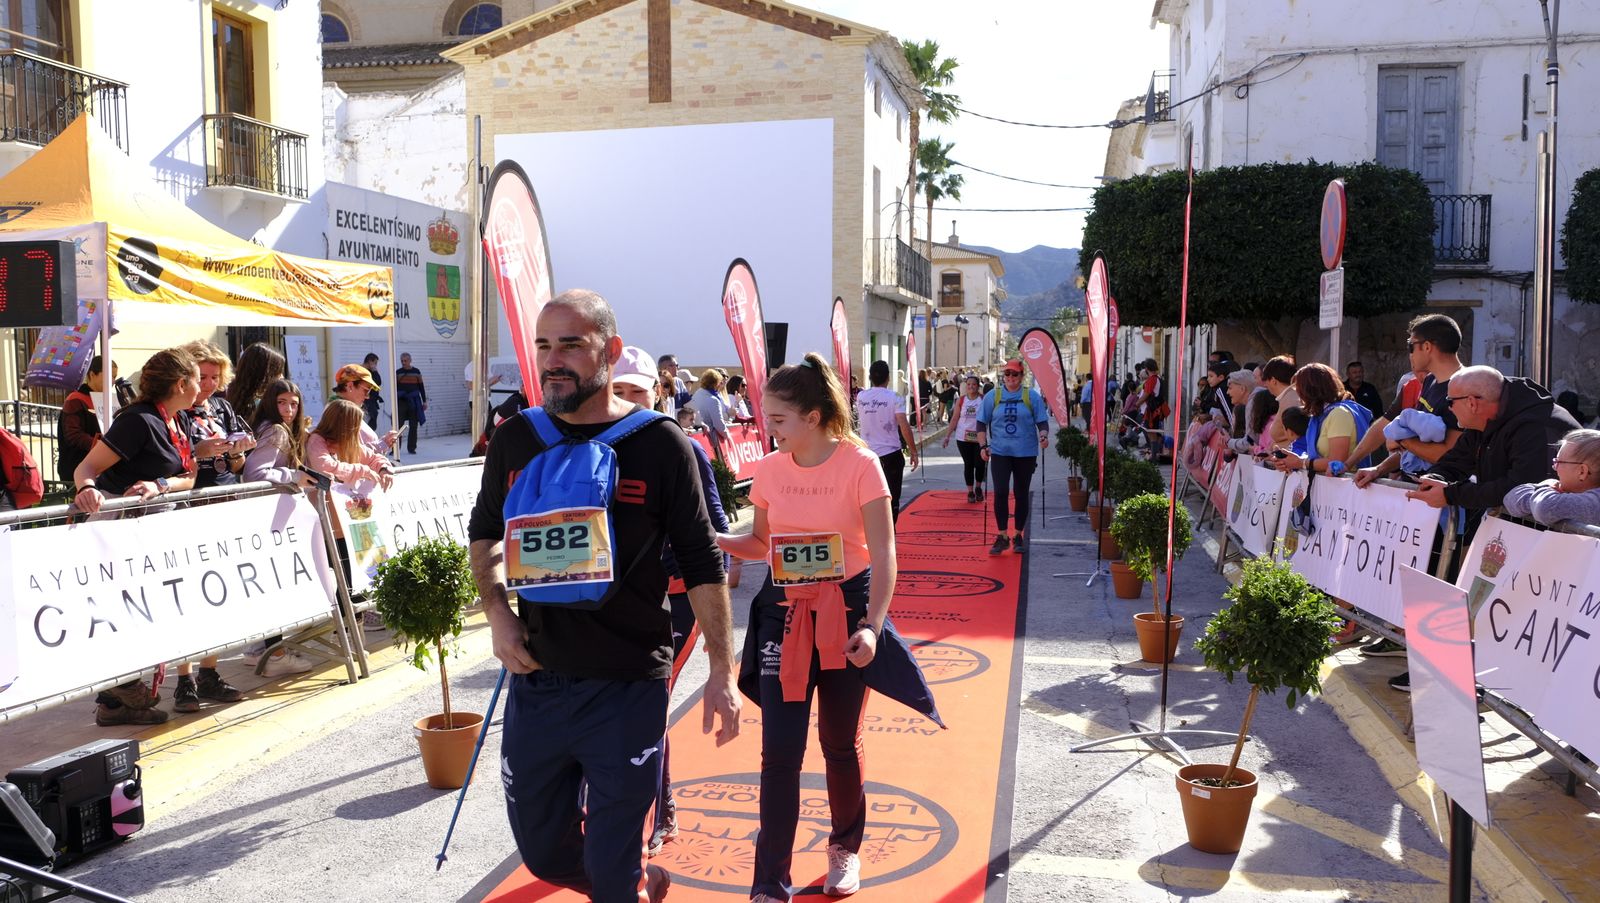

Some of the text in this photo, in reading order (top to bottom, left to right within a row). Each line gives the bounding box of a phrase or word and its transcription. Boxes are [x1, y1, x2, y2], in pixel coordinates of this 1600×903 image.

[336, 209, 421, 242] EXCELENTÍSIMO
[125, 254, 140, 263] uno
[338, 239, 420, 268] AYUNTAMIENTO
[390, 491, 480, 517] AYUNTAMIE
[780, 485, 835, 496] JOHNSMITH
[522, 525, 589, 553] 582
[1399, 525, 1421, 547] DE
[29, 526, 298, 593] AYUNTAMIENTO DE
[783, 545, 829, 563] 615
[33, 551, 313, 648] CANTORIA
